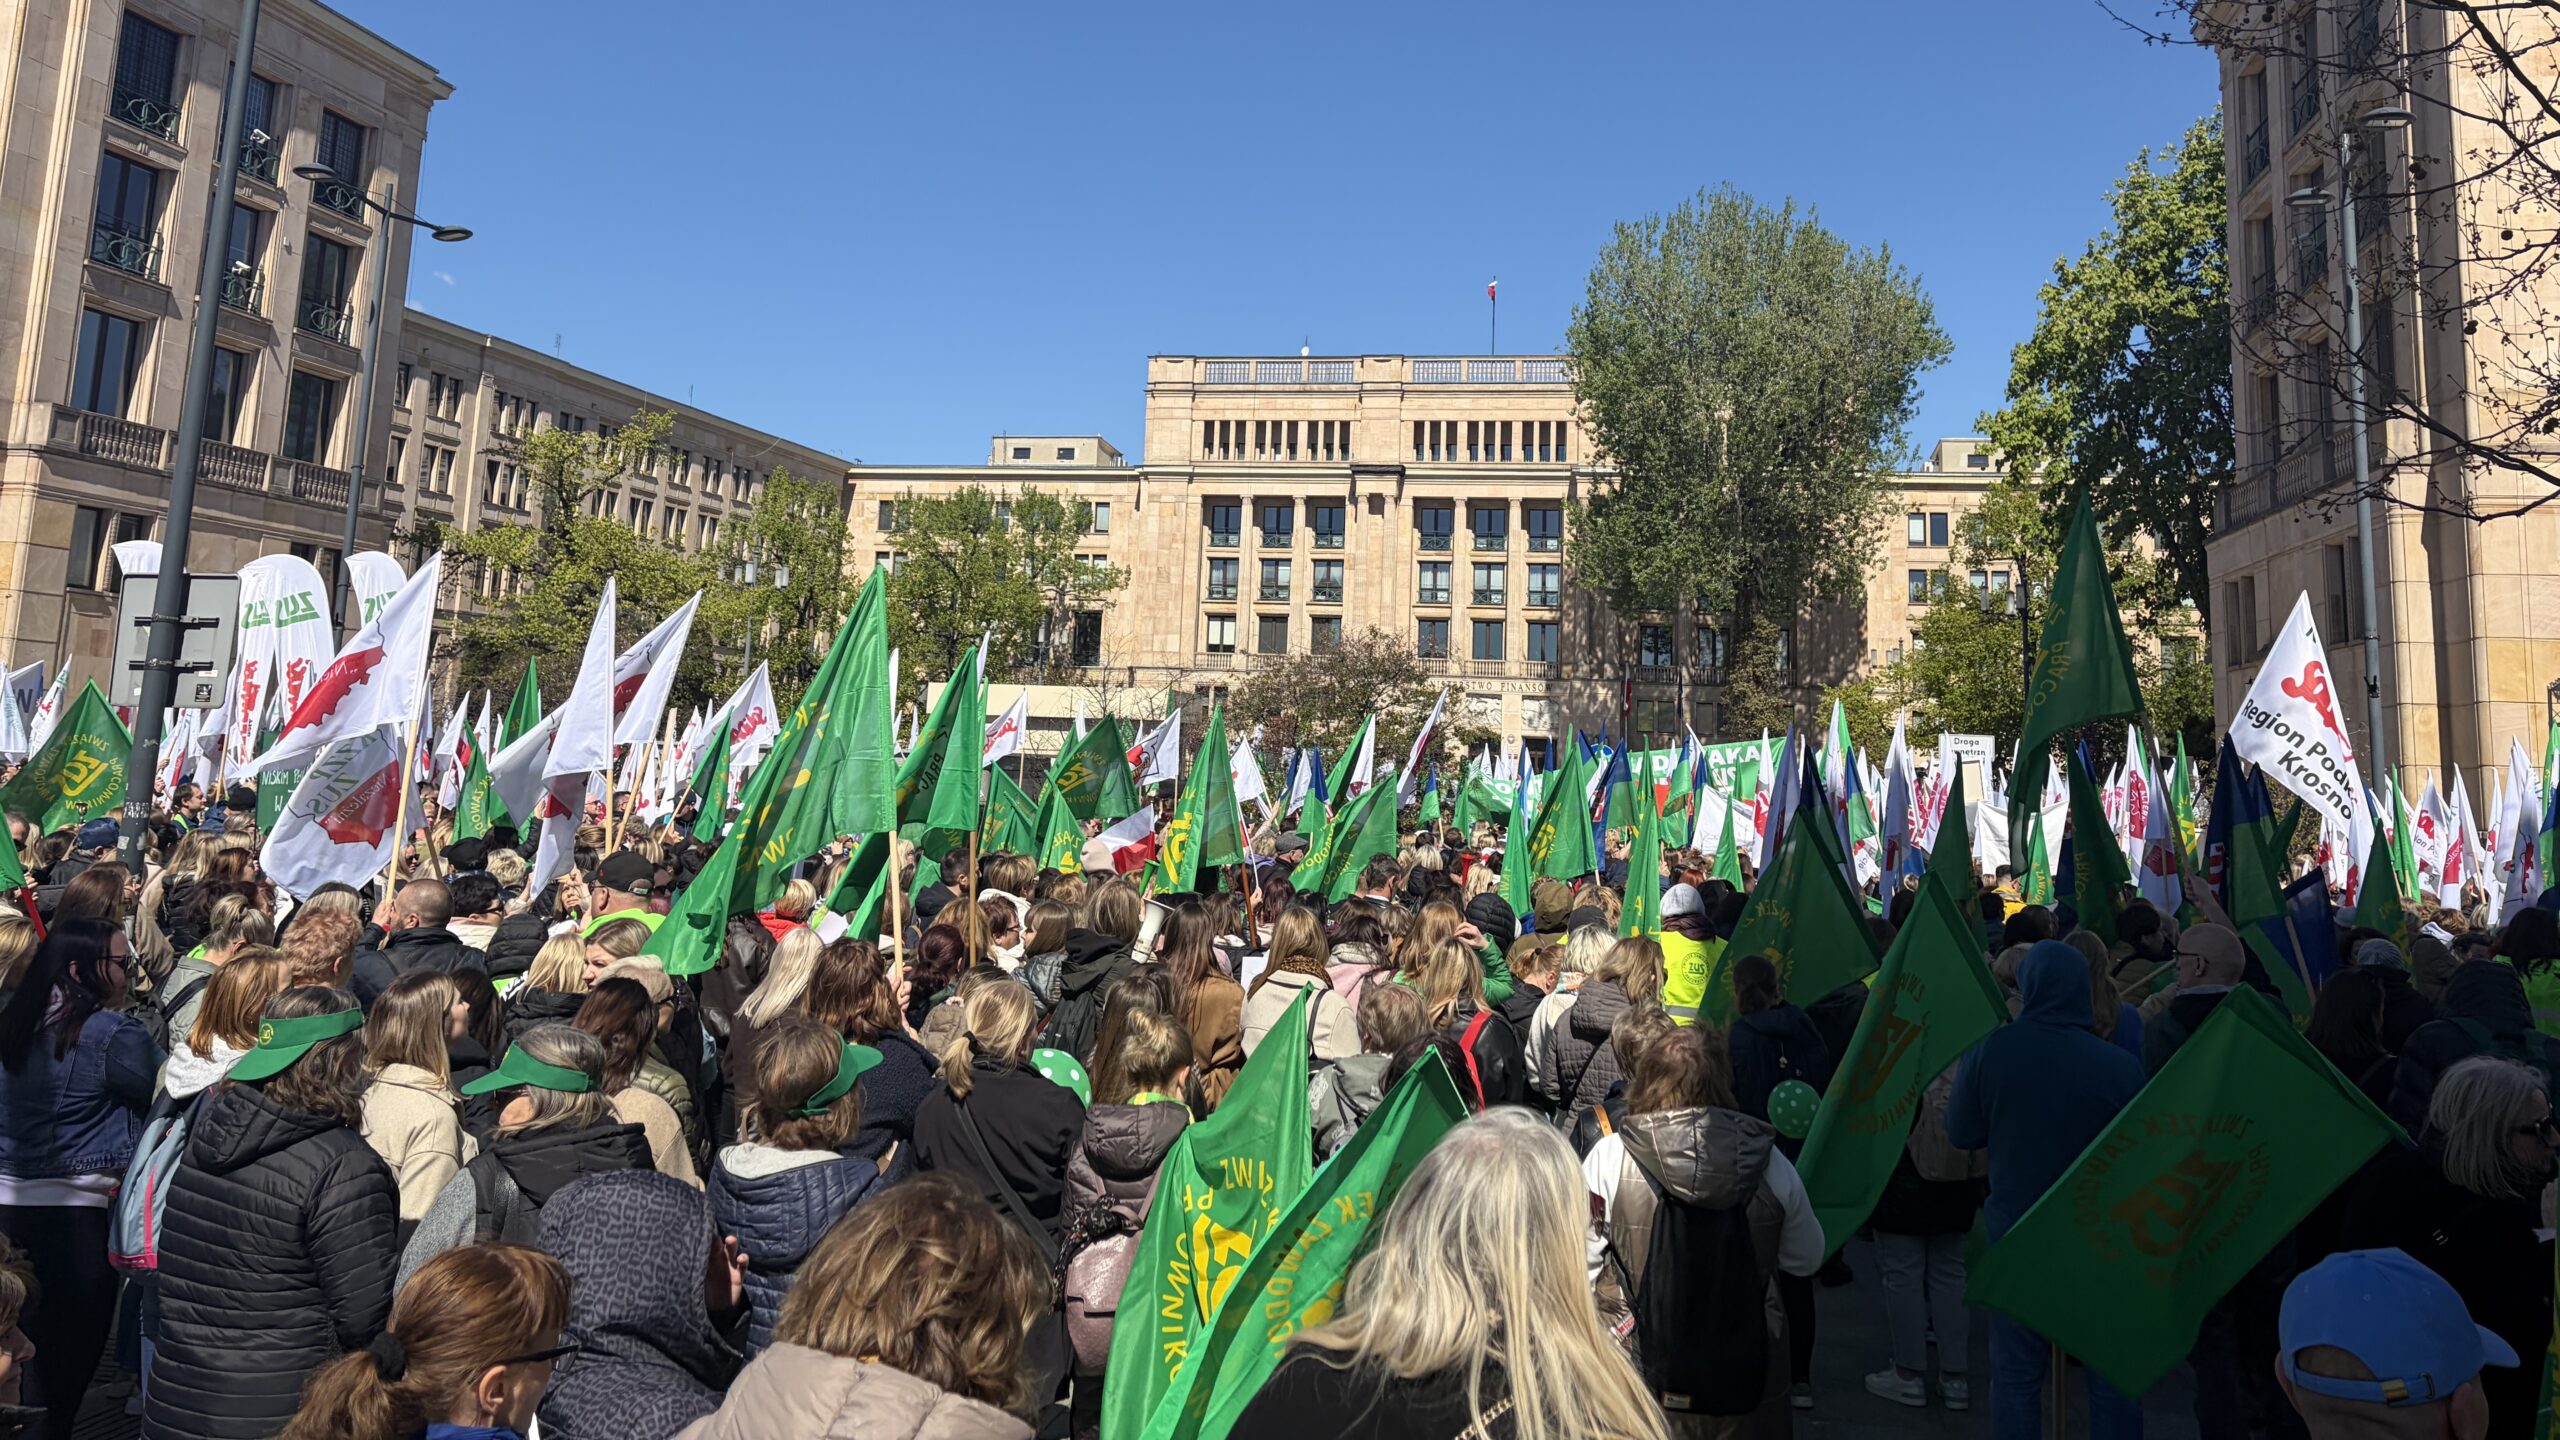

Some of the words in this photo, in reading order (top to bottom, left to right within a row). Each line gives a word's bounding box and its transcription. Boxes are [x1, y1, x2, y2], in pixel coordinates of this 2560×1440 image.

[2242, 699, 2305, 749] Region
[1954, 737, 1980, 748] Droga
[2278, 750, 2352, 820] Krosno
[1688, 962, 1705, 975] ZUS
